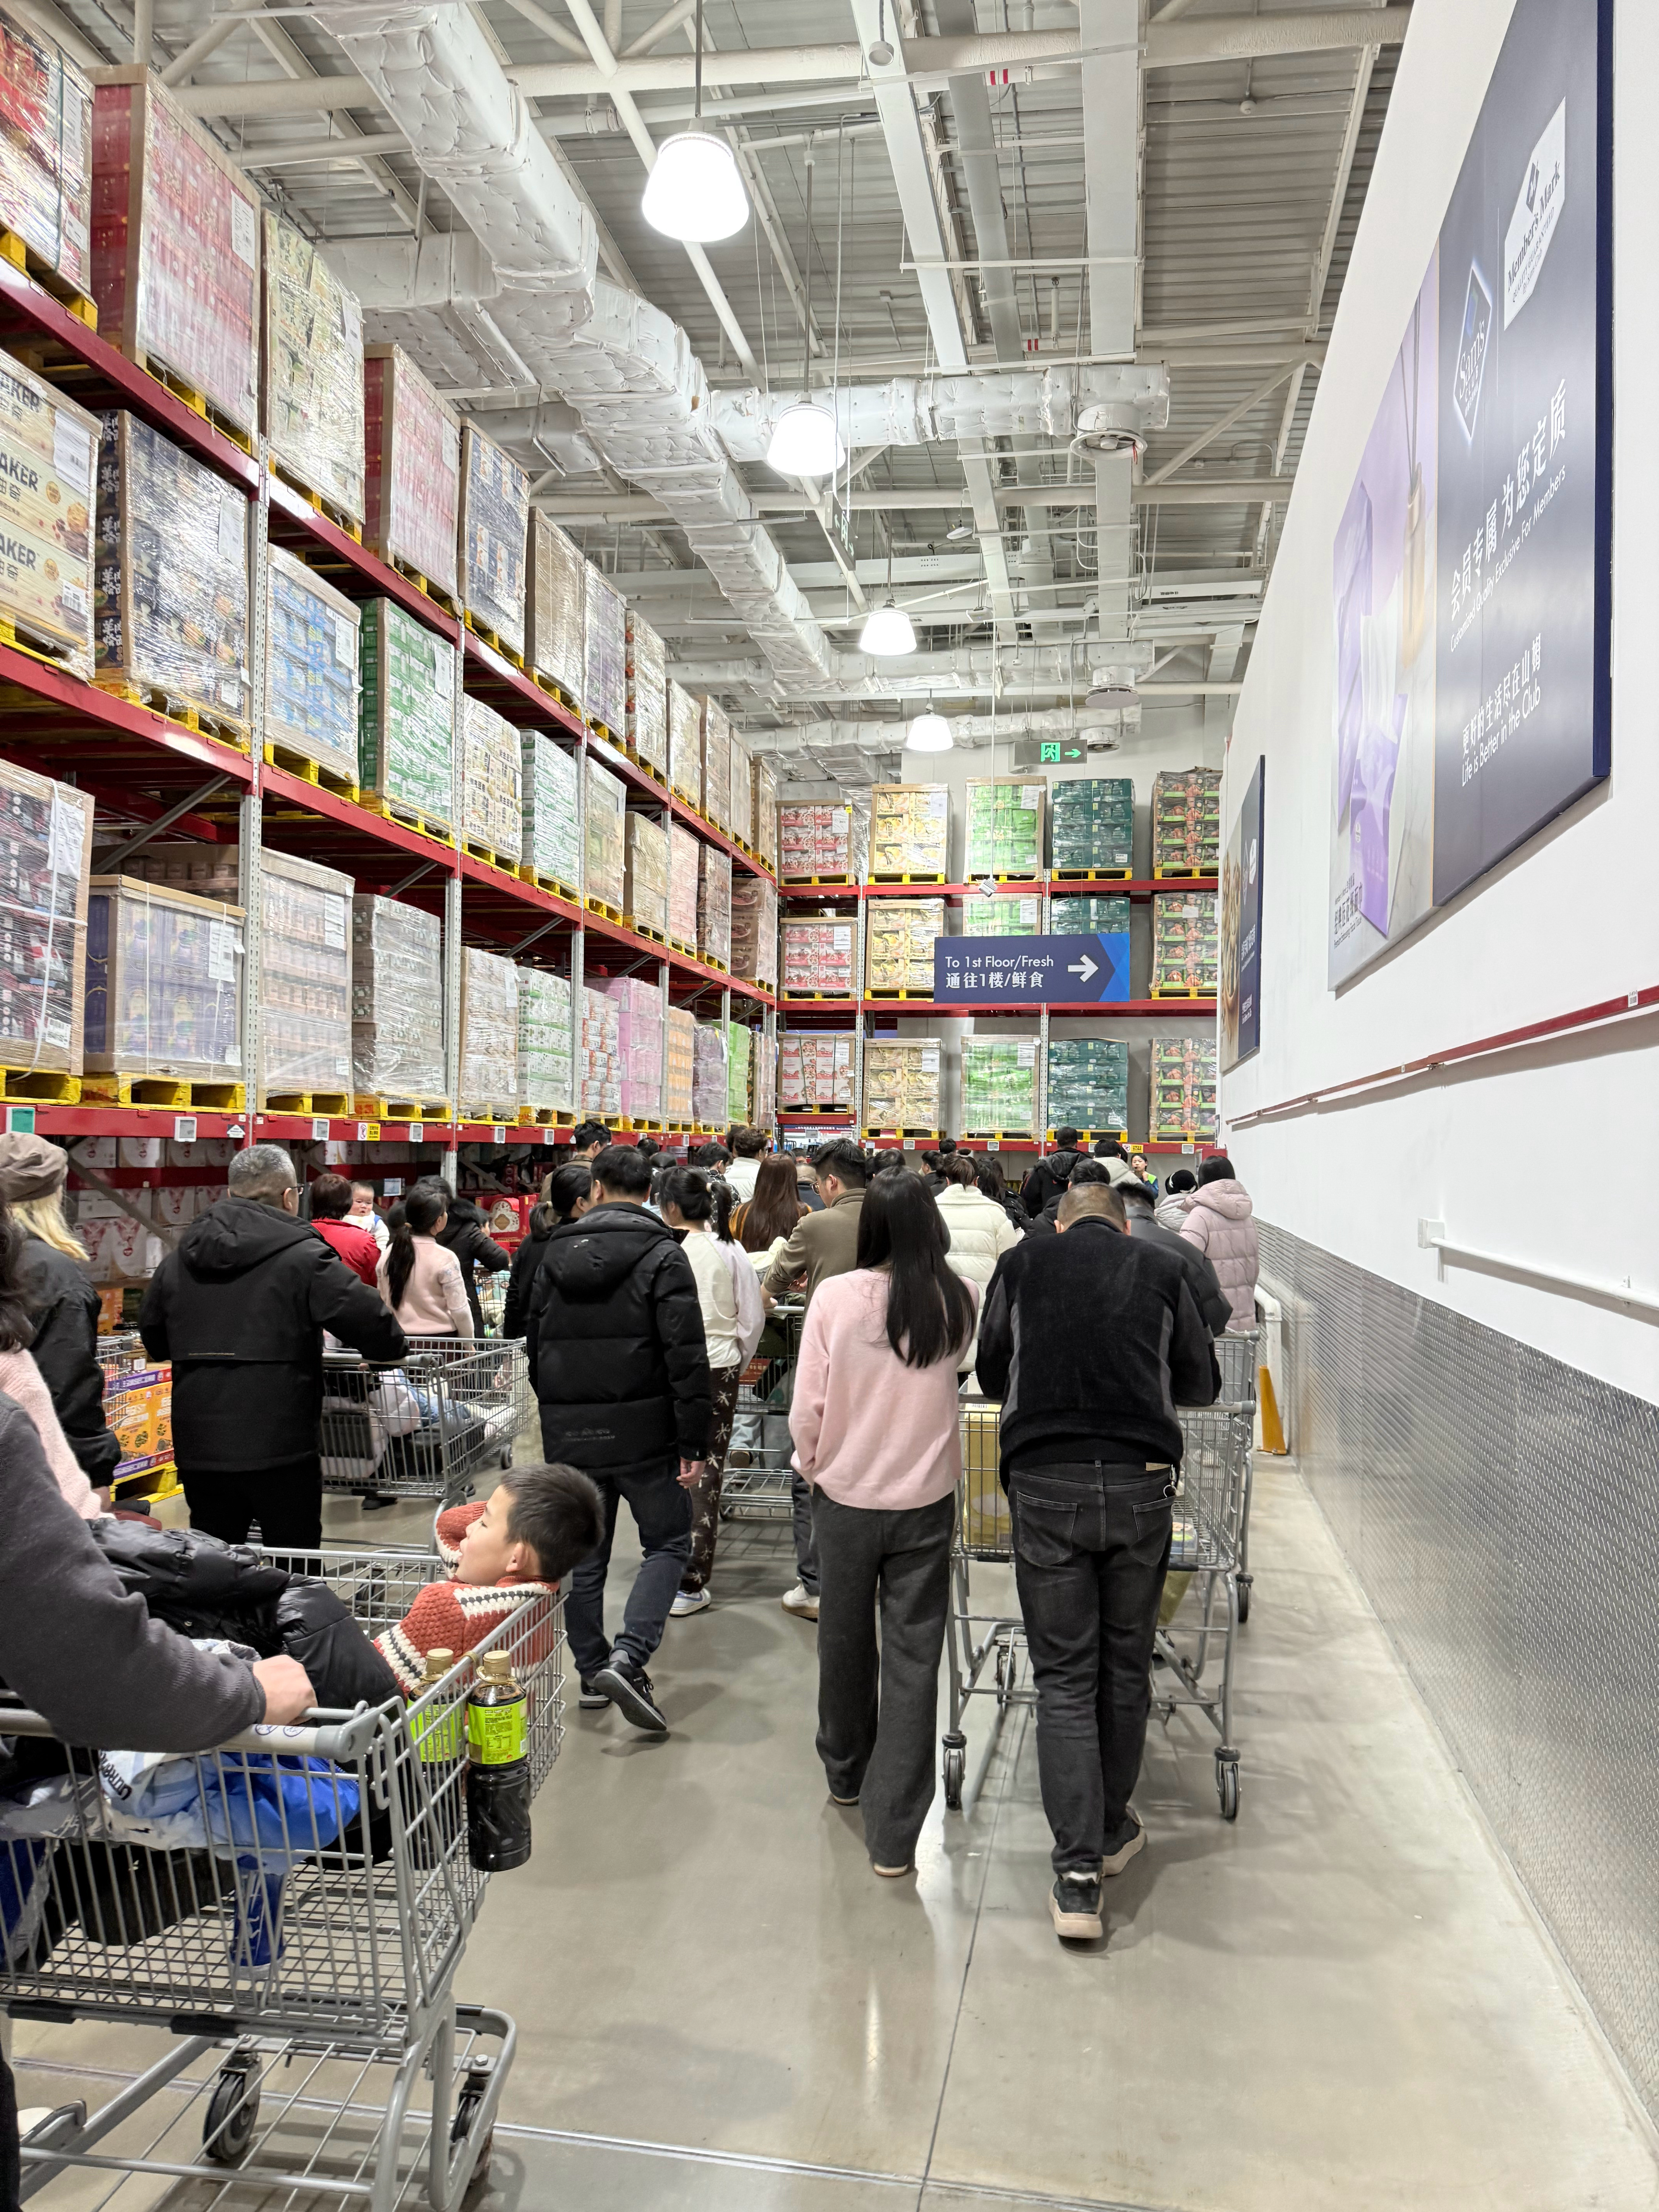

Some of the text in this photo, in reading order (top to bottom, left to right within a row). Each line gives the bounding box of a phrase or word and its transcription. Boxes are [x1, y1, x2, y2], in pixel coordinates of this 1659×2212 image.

[1508, 160, 1560, 292] Member's Mark
[1459, 319, 1485, 401] Sam's
[1451, 465, 1565, 652] Customized Quality Exclusive For Members
[1462, 678, 1541, 787] Life is Better in the Club
[1463, 633, 1541, 759] 更好的生活尽在山姆
[945, 955, 1054, 970] To 1st Floor/Fresh
[945, 971, 1044, 989] 通往1楼/鲜食
